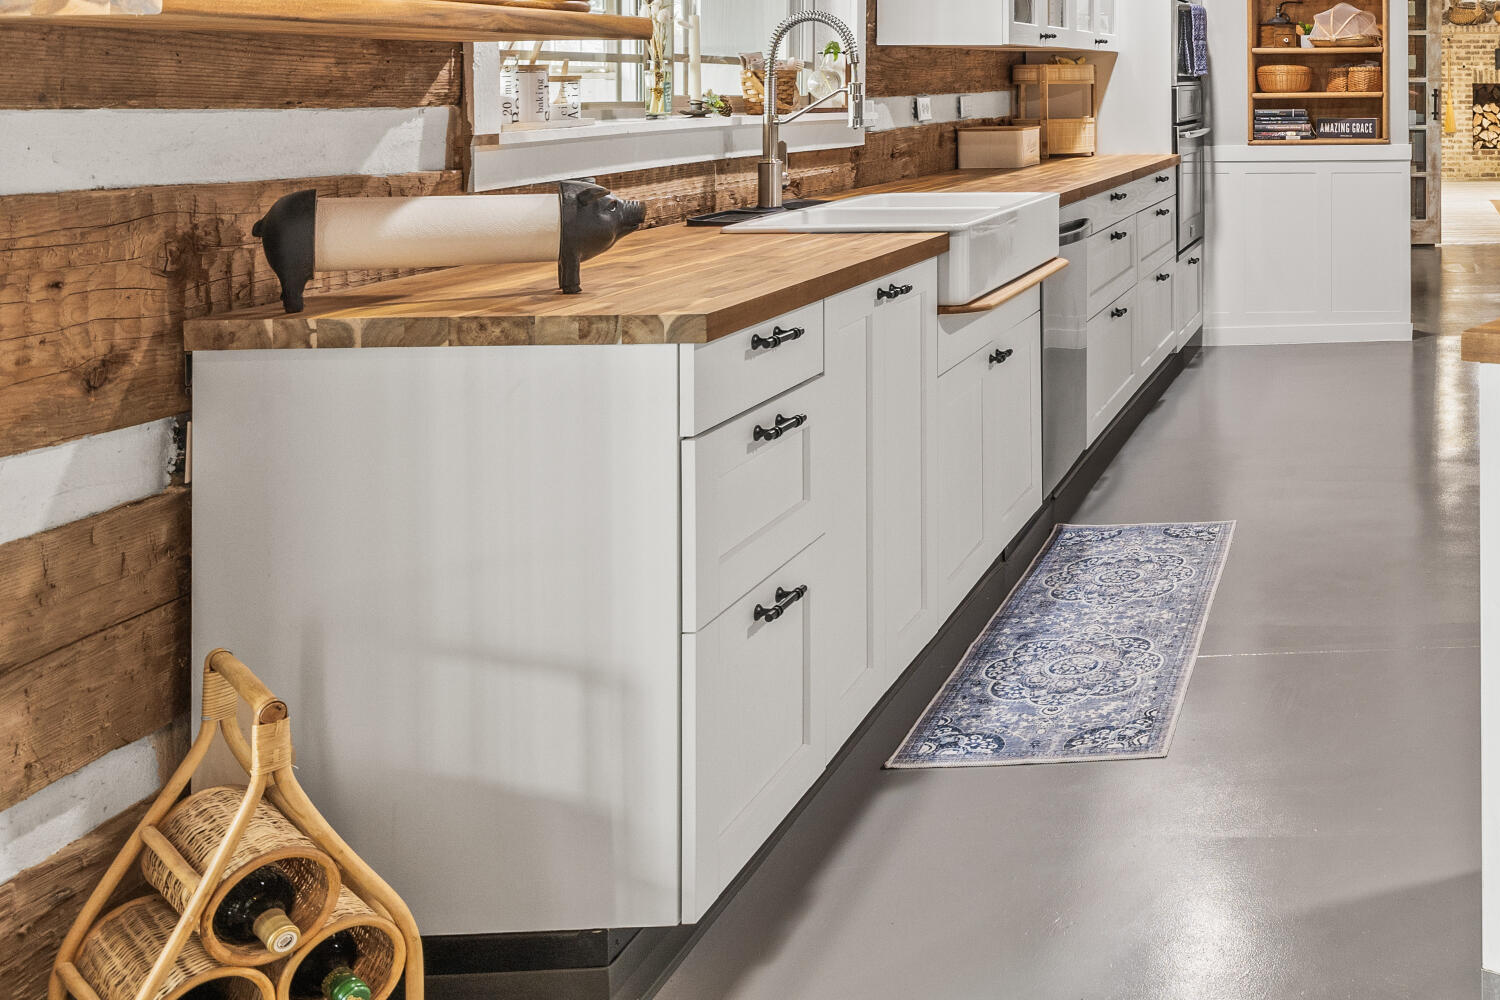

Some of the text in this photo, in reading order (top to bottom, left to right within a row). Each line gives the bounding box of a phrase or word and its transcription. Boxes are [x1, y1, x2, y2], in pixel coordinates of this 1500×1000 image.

[501, 66, 513, 116] 20 mule
[536, 79, 545, 114] baking
[567, 82, 579, 119] Acid
[1320, 122, 1373, 134] AMAZING GRACE
